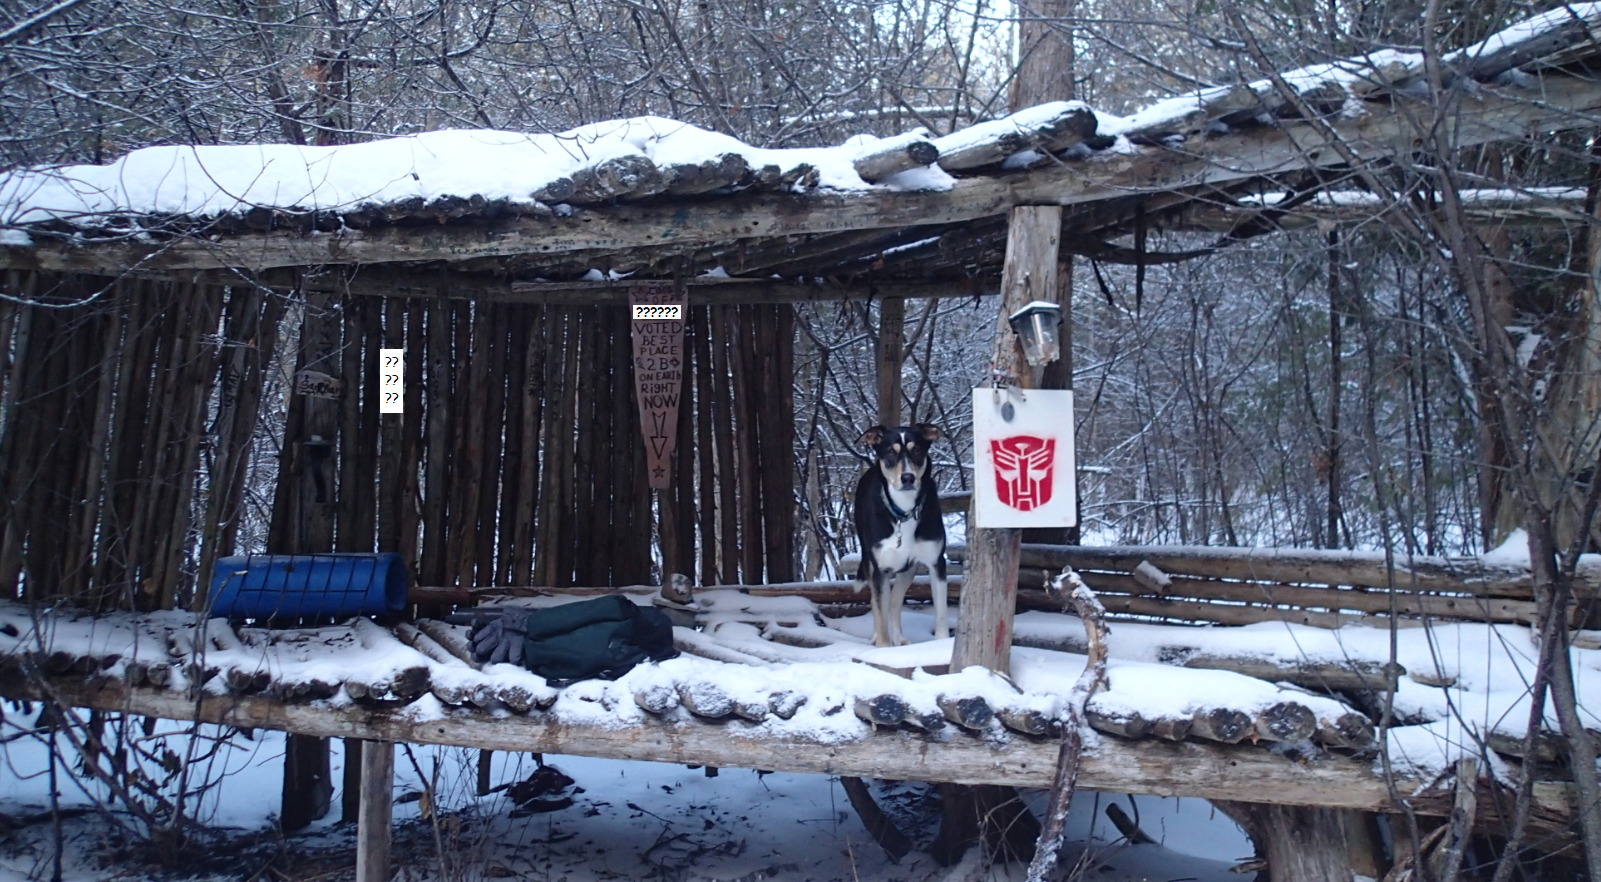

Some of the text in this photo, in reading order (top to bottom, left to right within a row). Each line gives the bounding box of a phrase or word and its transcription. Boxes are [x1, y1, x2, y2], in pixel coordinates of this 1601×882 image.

[634, 321, 683, 335] VOTED
[641, 335, 676, 346] BEST
[640, 345, 678, 356] PLACE
[647, 357, 669, 371] 2 B
[639, 373, 653, 382] ON
[644, 393, 679, 410] NOW
